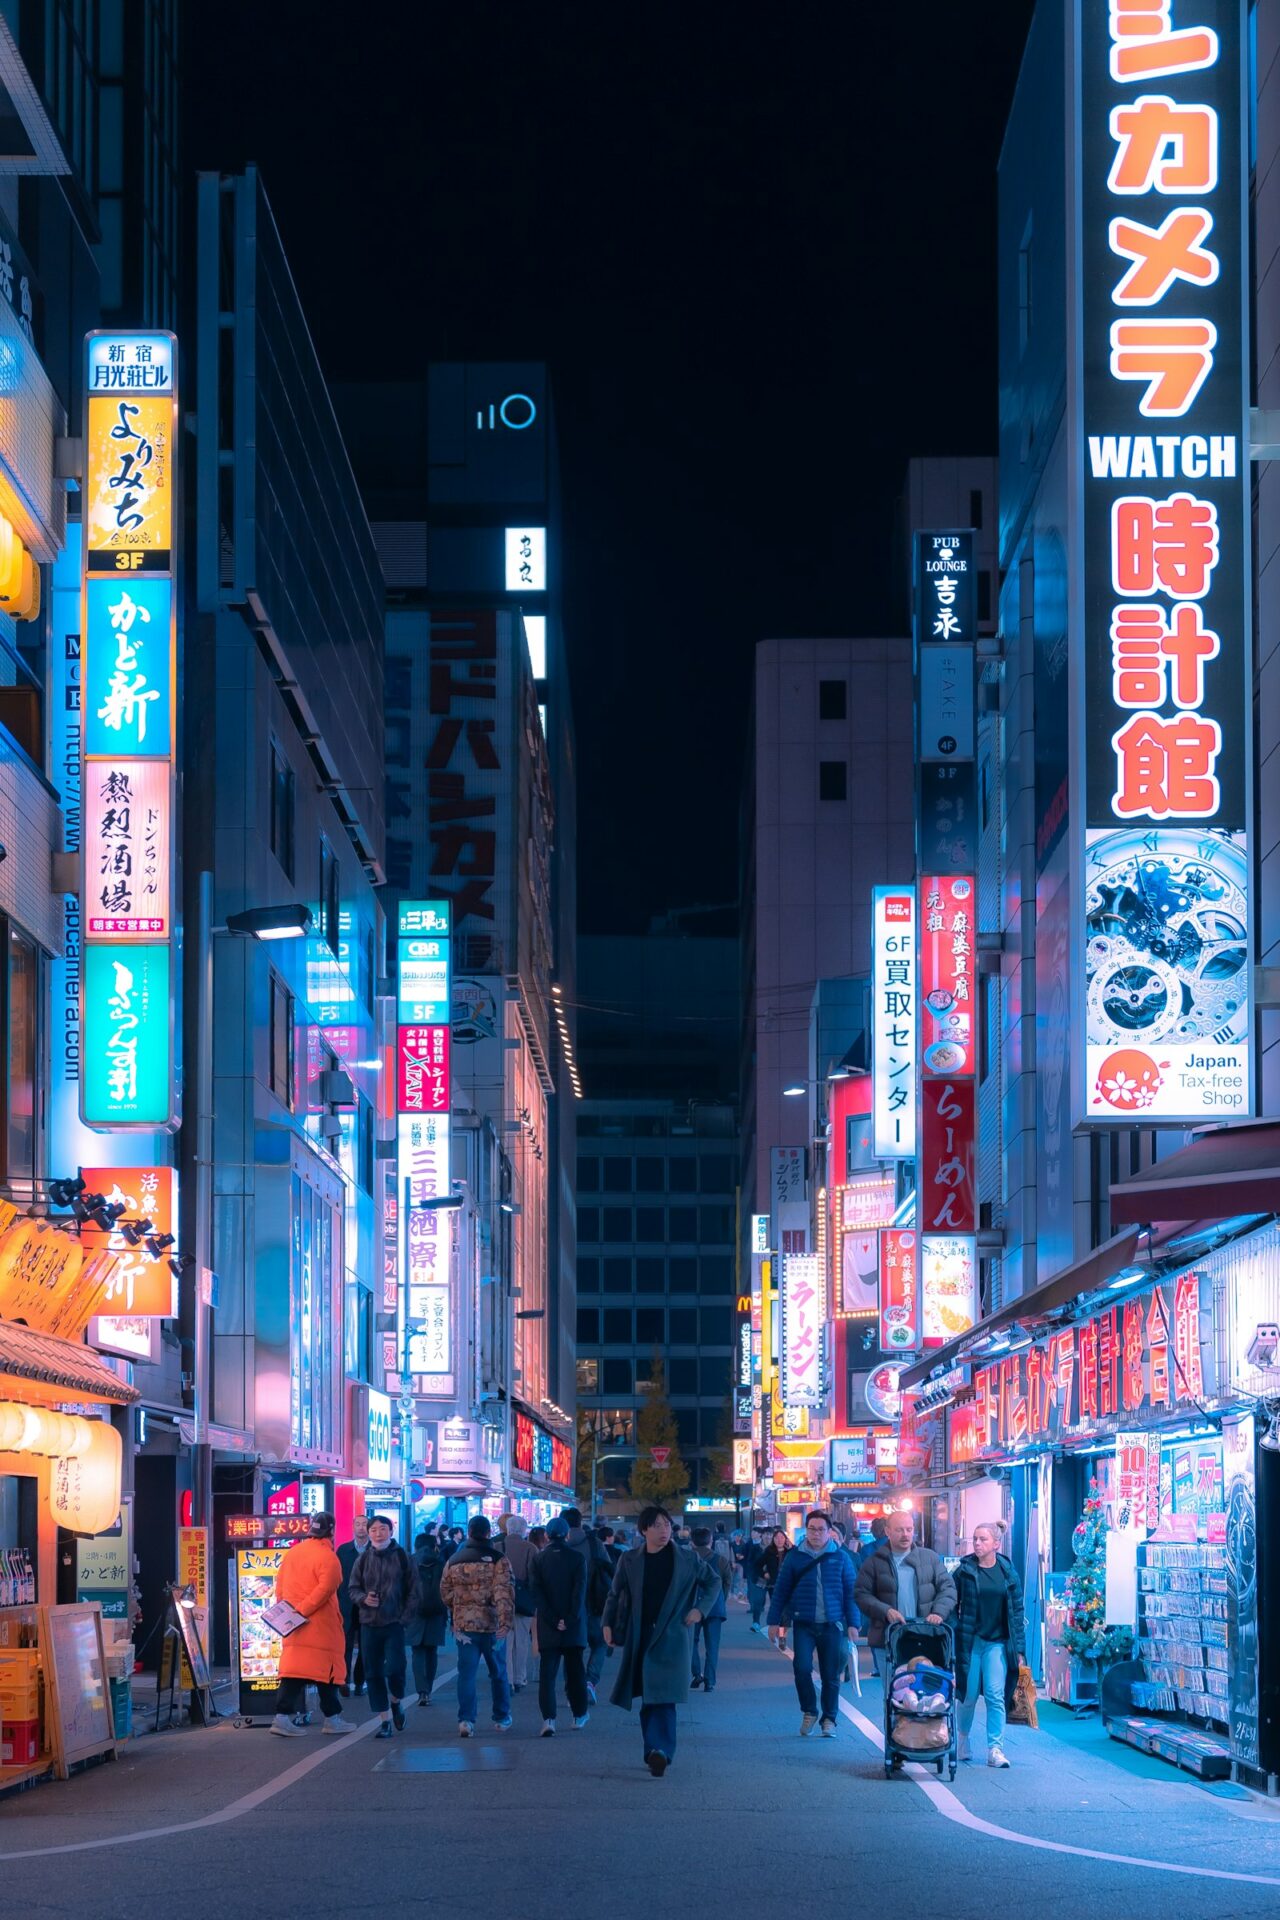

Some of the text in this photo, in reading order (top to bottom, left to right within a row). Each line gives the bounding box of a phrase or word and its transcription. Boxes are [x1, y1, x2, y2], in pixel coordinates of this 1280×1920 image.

[108, 344, 152, 362] 新宿
[109, 402, 153, 530] よりみち
[1088, 435, 1237, 478] WATCH
[932, 538, 960, 549] PUB
[115, 552, 144, 570] 3F
[926, 561, 967, 573] LOUNGE
[933, 575, 961, 640] 吉永
[97, 591, 161, 743] かど新
[1111, 492, 1222, 818] 時計館
[942, 667, 957, 721] FAKE
[940, 741, 954, 753] 4F
[92, 919, 162, 931] 朝まで営業中
[926, 891, 946, 933] 元祖
[885, 936, 911, 952] 6F
[950, 911, 972, 1001] 麻婆豆腐
[413, 1005, 435, 1020] 5F
[884, 959, 912, 1143] 買取センター
[432, 1067, 444, 1107] シーアン
[1179, 1074, 1243, 1088] Tax-free
[1202, 1091, 1243, 1106] Shop
[932, 1085, 965, 1227] らーめん
[885, 1241, 898, 1268] 元祖
[790, 1281, 816, 1377] ラーメン
[740, 1322, 751, 1386] McDonald's
[1119, 1446, 1147, 1474] 10
[80, 1566, 126, 1580] かど新
